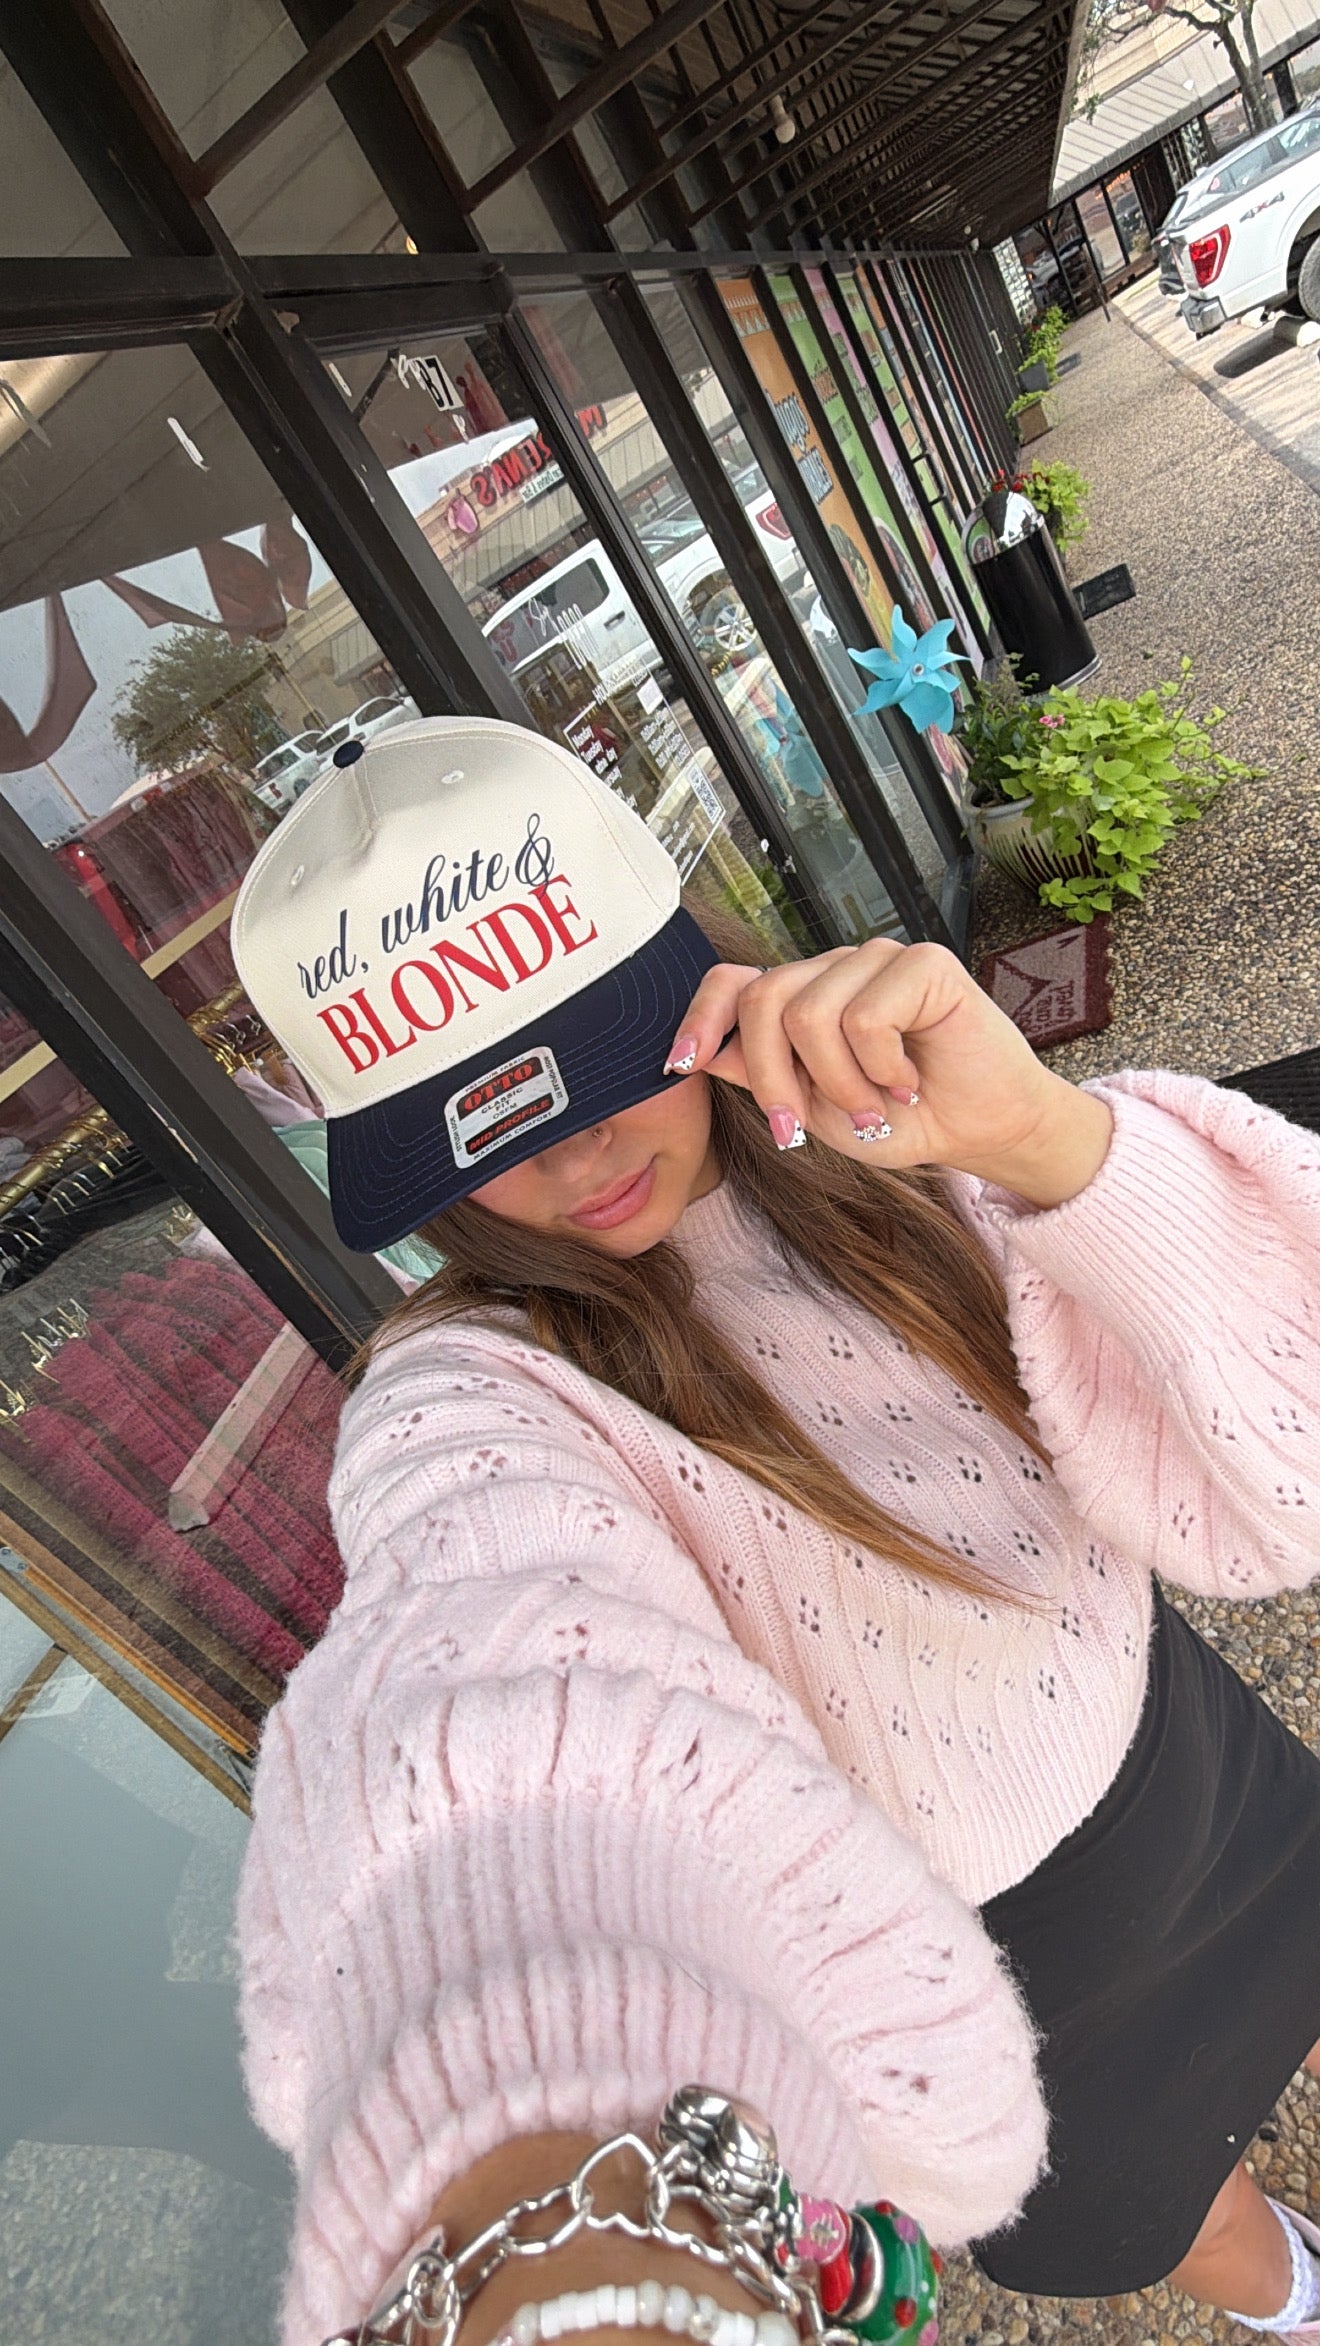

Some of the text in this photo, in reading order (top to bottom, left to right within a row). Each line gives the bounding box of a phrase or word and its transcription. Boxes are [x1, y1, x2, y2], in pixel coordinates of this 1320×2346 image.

[297, 813, 556, 999] red, white &
[317, 874, 598, 1074] BLONDE
[464, 1064, 533, 1110] OTTO
[465, 1056, 525, 1092] PREMIUM FABRIC
[481, 1087, 523, 1114] CLASSIC
[492, 1103, 517, 1119] OSFM
[495, 1100, 511, 1111] FIT
[469, 1131, 493, 1150] MID
[495, 1099, 551, 1134] PROFILE
[473, 1133, 512, 1160] MAXIMUM
[514, 1111, 552, 1134] COMFORT
